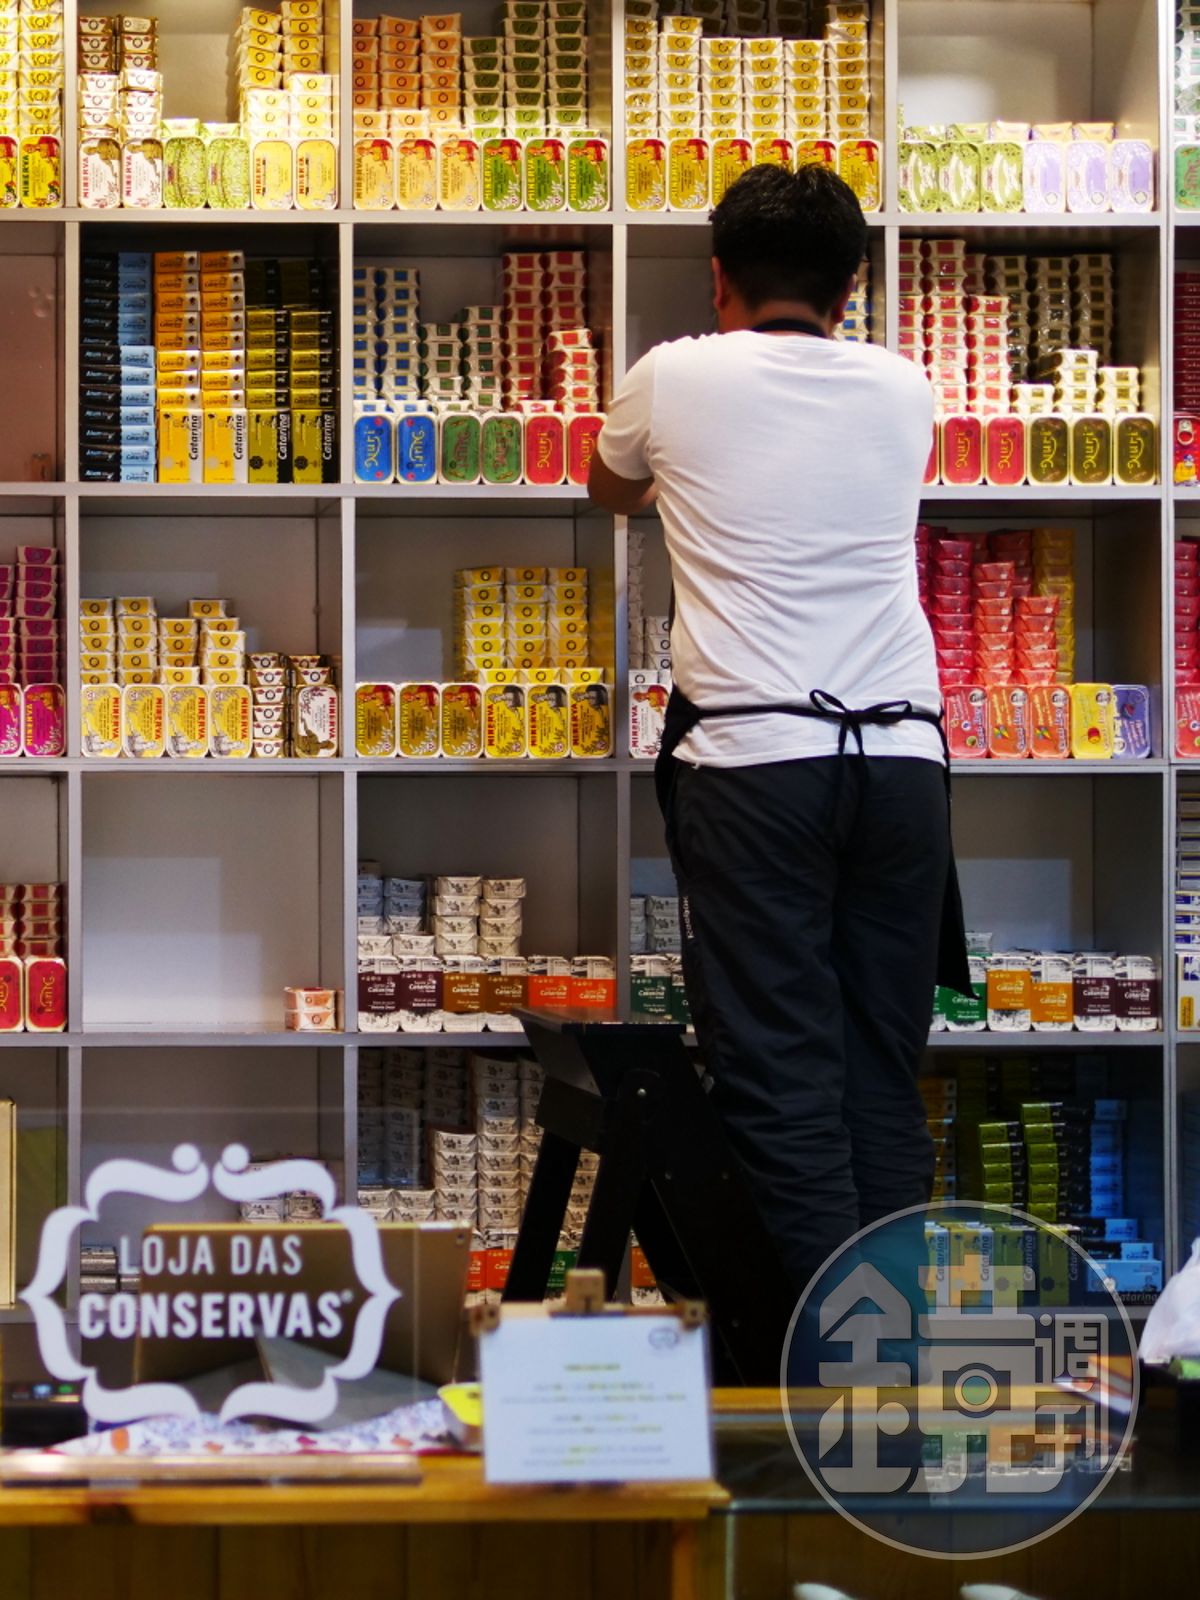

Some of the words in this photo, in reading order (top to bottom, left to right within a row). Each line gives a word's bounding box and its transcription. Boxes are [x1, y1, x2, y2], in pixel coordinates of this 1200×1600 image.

[22, 154, 30, 197] MINERVA
[125, 156, 133, 198] MINERVA
[484, 157, 492, 201] MINERVA
[527, 157, 535, 201] MINERVA
[188, 415, 198, 460] Catarina
[233, 415, 243, 460] Catarina
[277, 414, 288, 460] Catarina
[322, 414, 332, 460] Catarina
[365, 430, 382, 469] Nuri
[409, 429, 426, 469] Nuri
[537, 432, 554, 469] Nuri
[955, 432, 973, 468] Nuri
[998, 432, 1015, 470] Nuri
[1041, 431, 1057, 470] Nuri
[1084, 431, 1100, 470] Nuri
[1126, 431, 1144, 470] Nuri
[111, 697, 119, 739] MINERVA
[154, 697, 162, 740] MINERVA
[329, 697, 337, 739] MINERVA
[487, 704, 495, 746] MINERVA
[530, 704, 538, 746] MINERVA
[572, 703, 580, 746] MINERVA
[631, 705, 639, 747] MINERVA
[39, 976, 54, 1013] Nuri
[118, 1235, 214, 1276] LOJA
[230, 1235, 302, 1276] DAS
[78, 1292, 343, 1340] CONSERVAS
